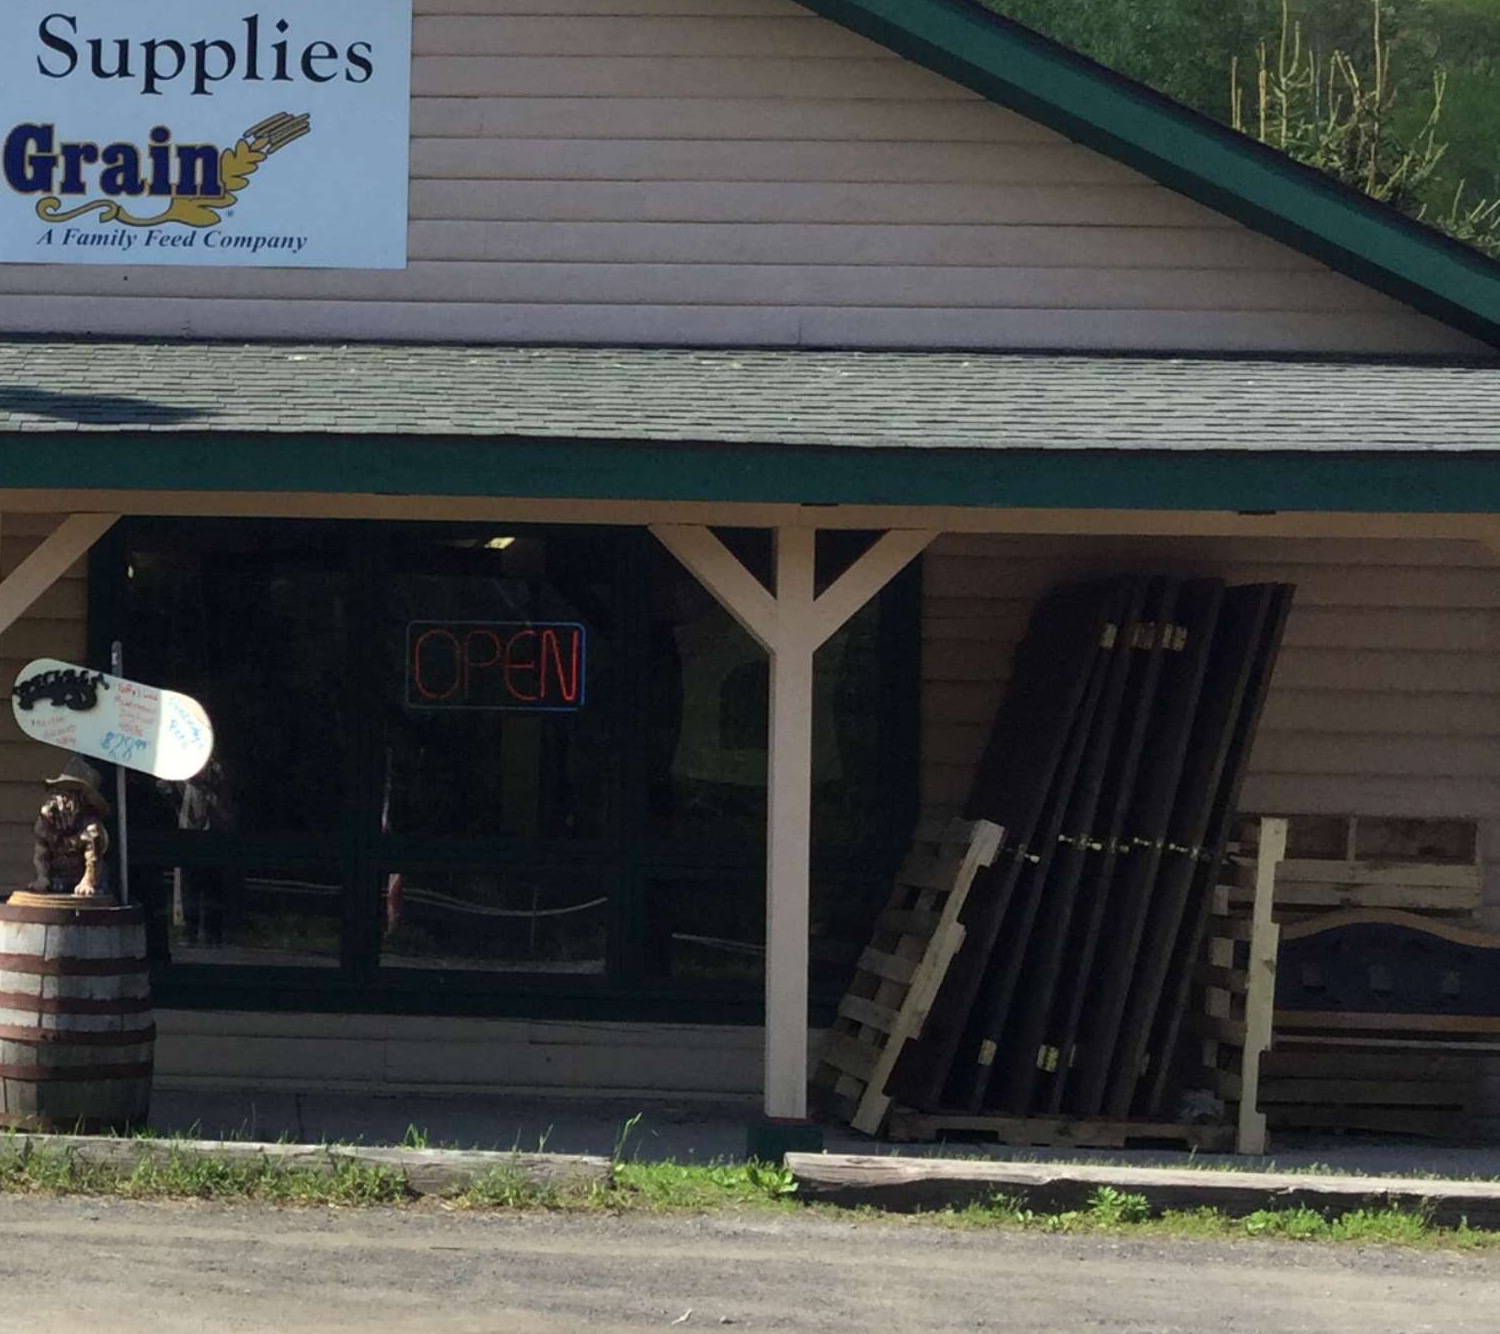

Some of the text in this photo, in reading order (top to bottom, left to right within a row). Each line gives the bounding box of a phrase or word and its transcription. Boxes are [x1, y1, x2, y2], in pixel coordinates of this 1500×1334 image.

[36, 13, 375, 96] Supplies
[36, 227, 308, 253] A Family Feed Company
[415, 629, 581, 701] OPEN
